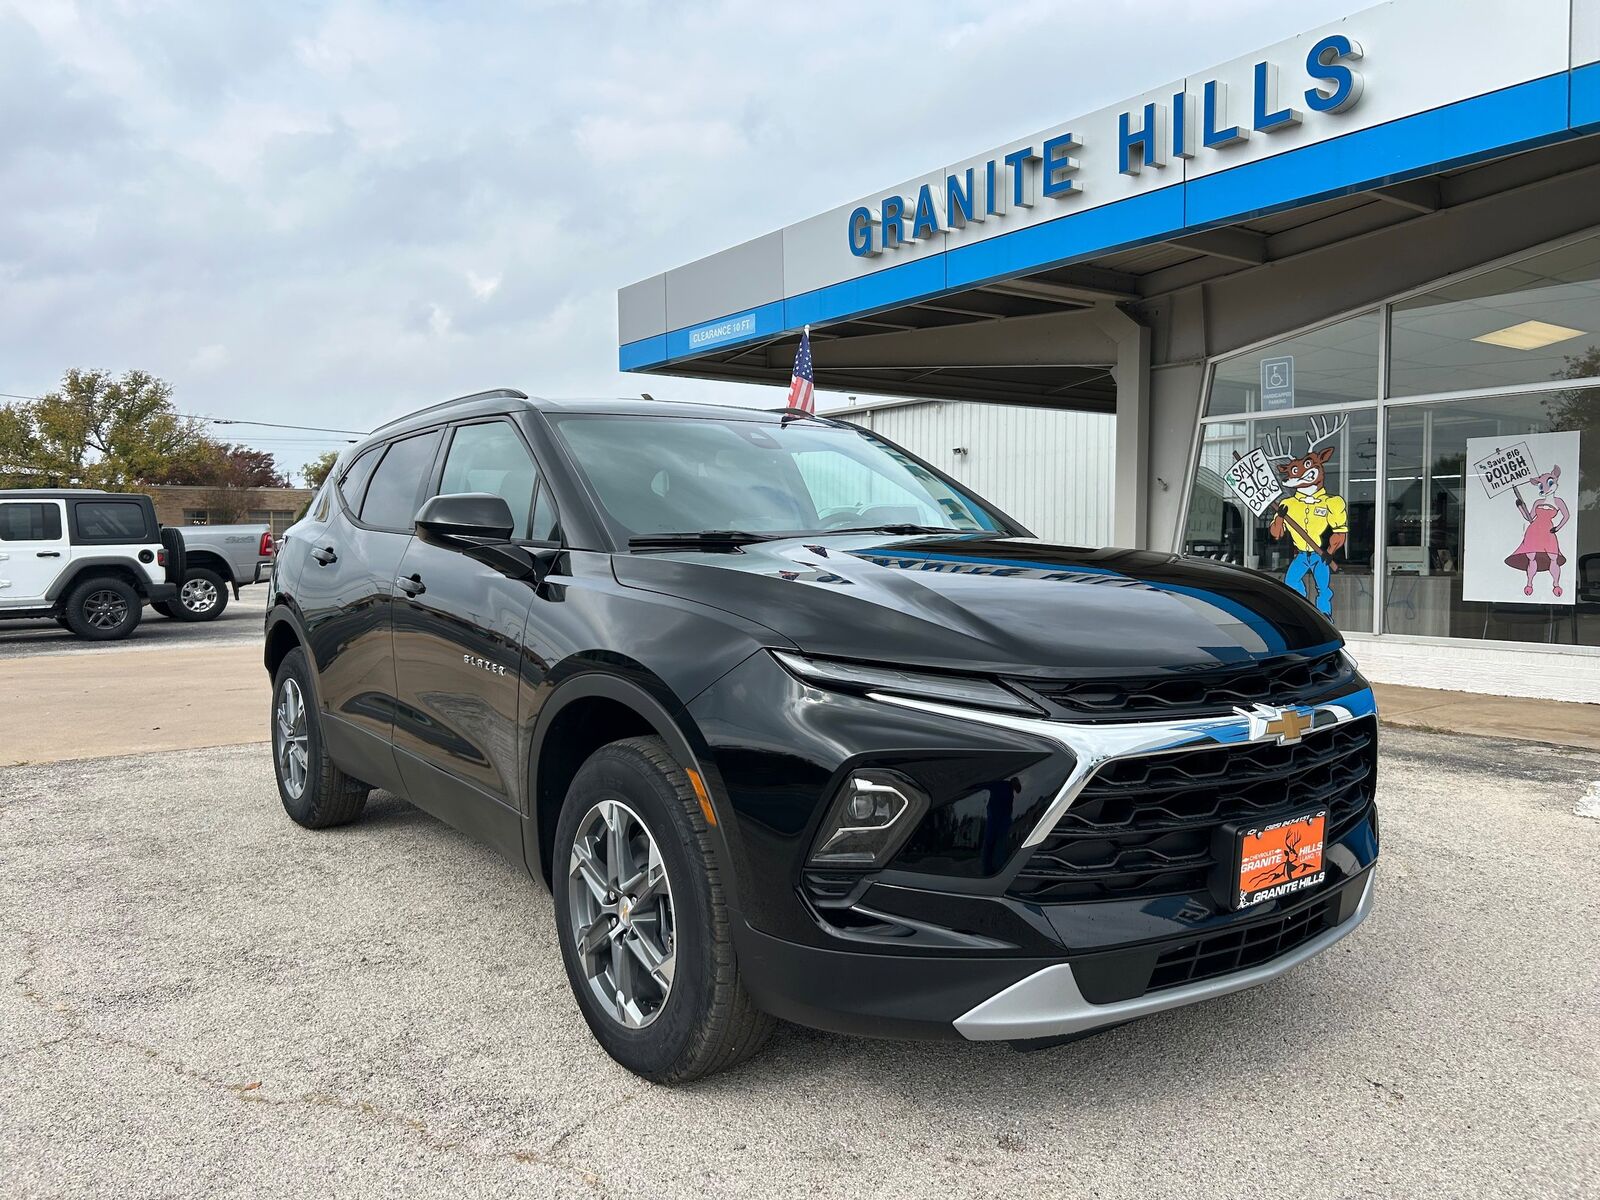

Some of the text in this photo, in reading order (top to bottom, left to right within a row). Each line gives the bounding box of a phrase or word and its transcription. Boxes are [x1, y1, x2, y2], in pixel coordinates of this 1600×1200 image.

[848, 35, 1364, 258] GRANITE HILLS
[693, 319, 751, 343] CLEARANCE 10 FT
[1232, 452, 1264, 482] SAVE
[1485, 455, 1527, 483] DOUGH
[1487, 456, 1507, 468] Save
[1506, 448, 1521, 460] BIG
[1238, 468, 1269, 498] BIG
[1490, 467, 1531, 490] in LLANO!
[1249, 480, 1279, 511] BUCKS
[463, 654, 507, 677] BLAZER
[1249, 849, 1275, 861] CHEVROLET
[1298, 841, 1324, 856] HILLS
[1241, 854, 1282, 873] GRANITE
[1253, 871, 1325, 903] GRANITE HILLS
